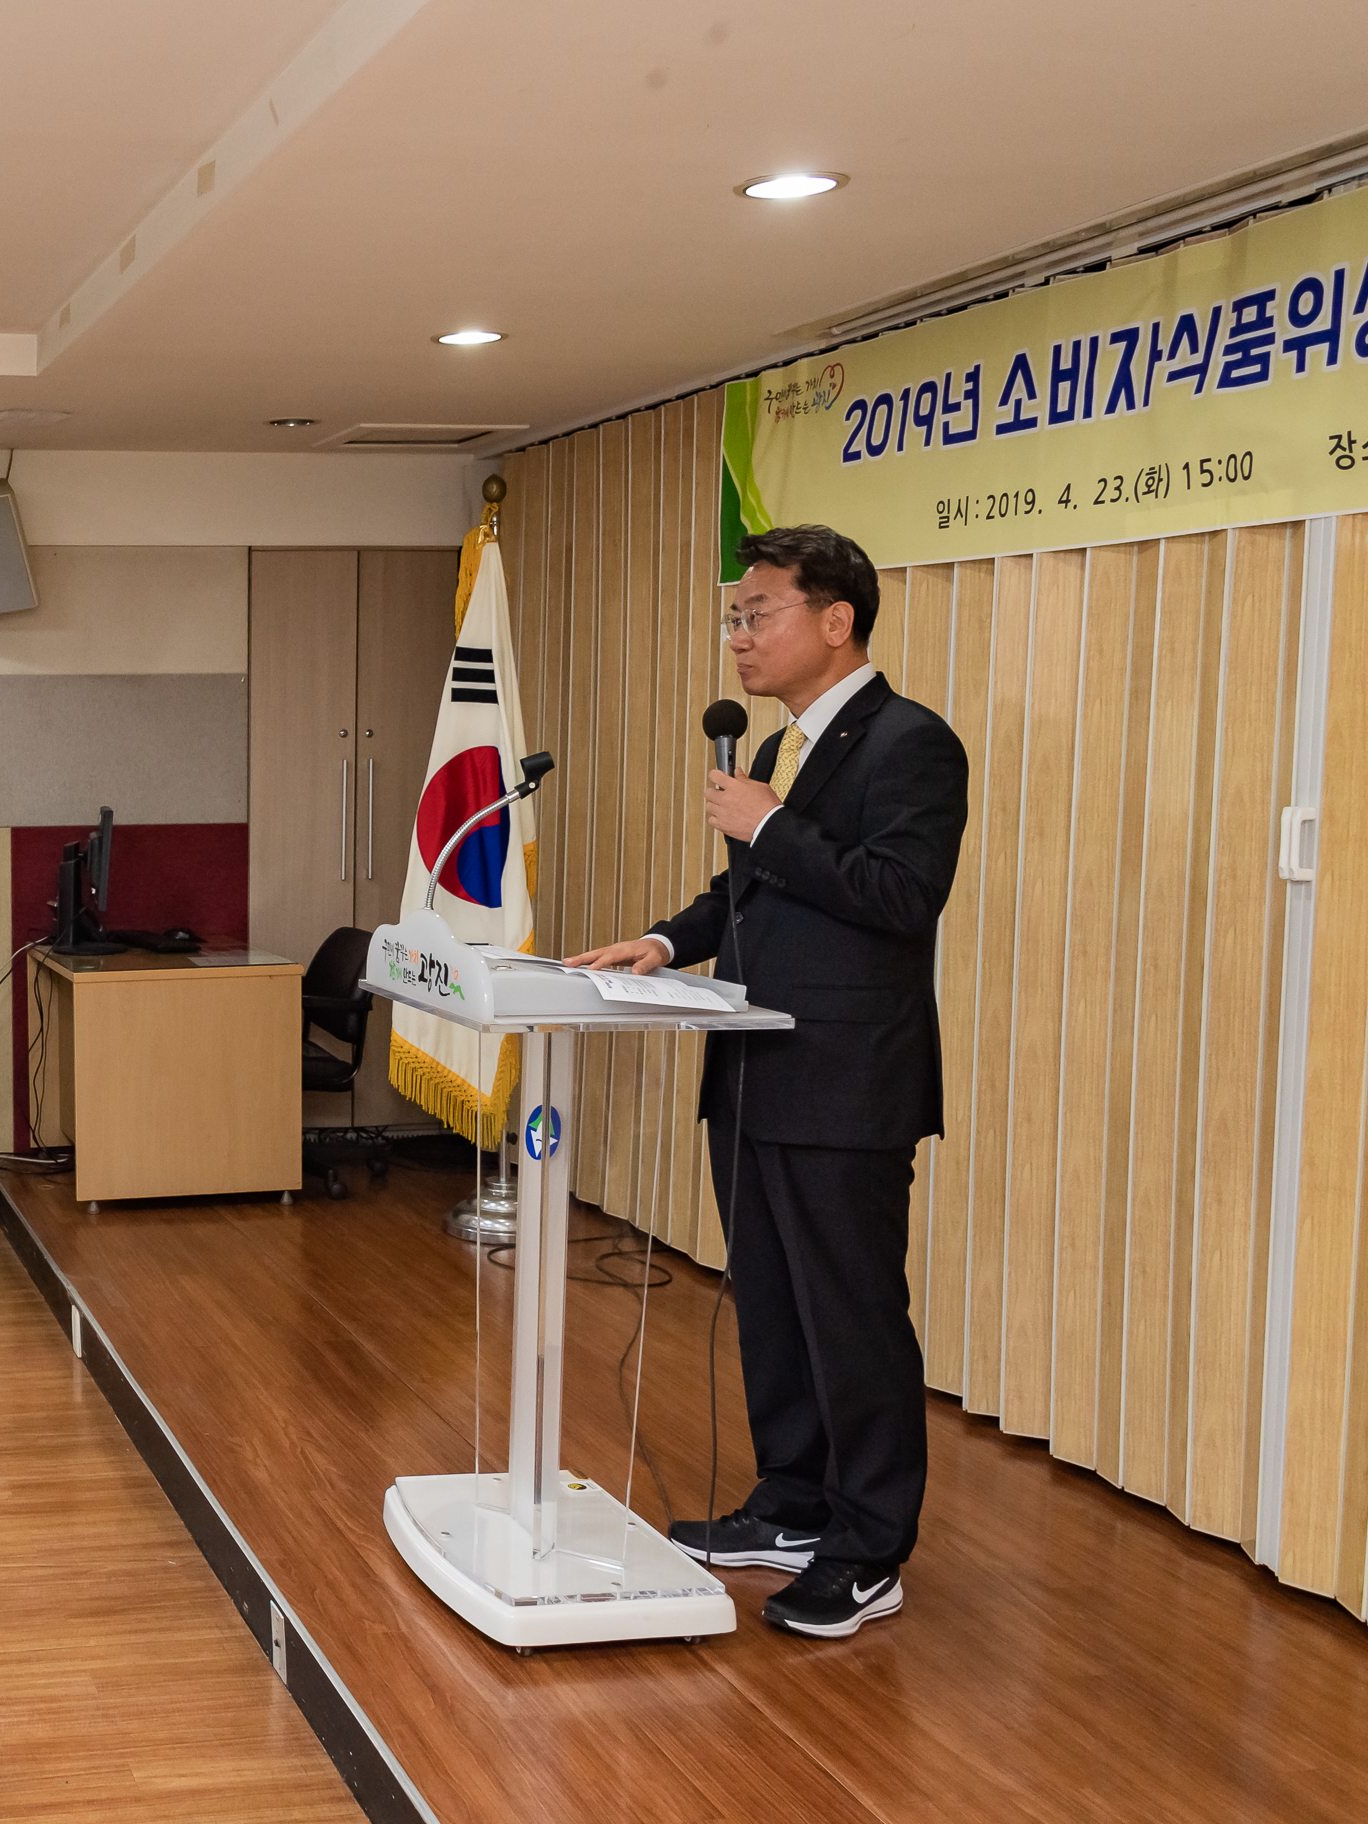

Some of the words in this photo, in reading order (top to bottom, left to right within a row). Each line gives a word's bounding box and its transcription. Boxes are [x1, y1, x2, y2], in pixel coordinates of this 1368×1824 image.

[842, 364, 981, 464] 2019년
[1328, 430, 1368, 470] 장
[1057, 483, 1078, 510] 4.
[1182, 451, 1254, 490] 15:00
[418, 952, 450, 996] 광진
